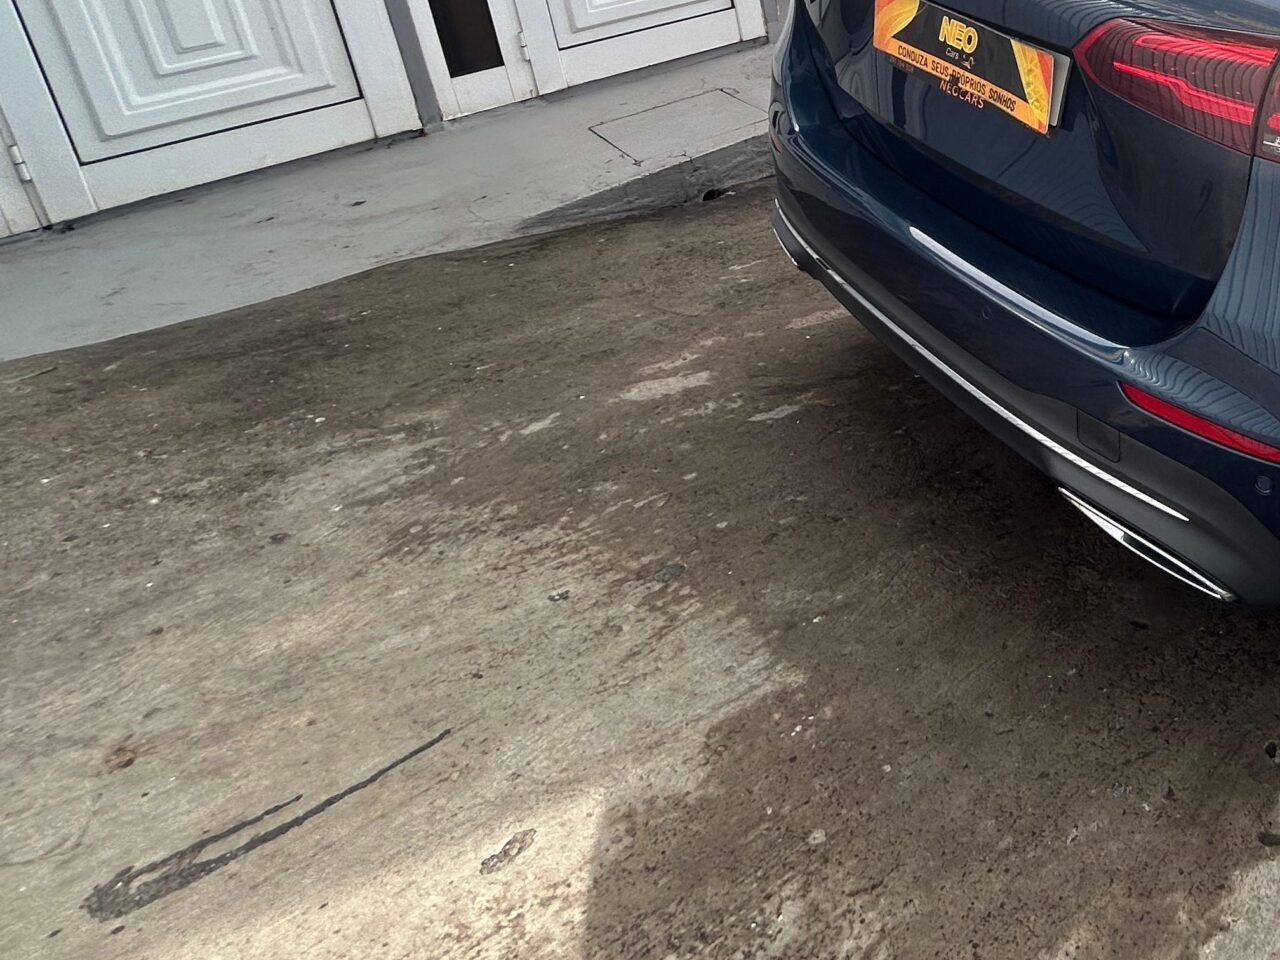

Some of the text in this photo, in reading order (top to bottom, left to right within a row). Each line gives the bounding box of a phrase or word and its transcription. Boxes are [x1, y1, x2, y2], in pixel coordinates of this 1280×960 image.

[938, 15, 979, 54] NEO
[945, 47, 960, 60] Cars
[897, 45, 928, 68] CONDUZA
[930, 60, 950, 78] SEUS
[950, 69, 987, 96] PRÓPRIOS
[988, 88, 1017, 112] SONHOS
